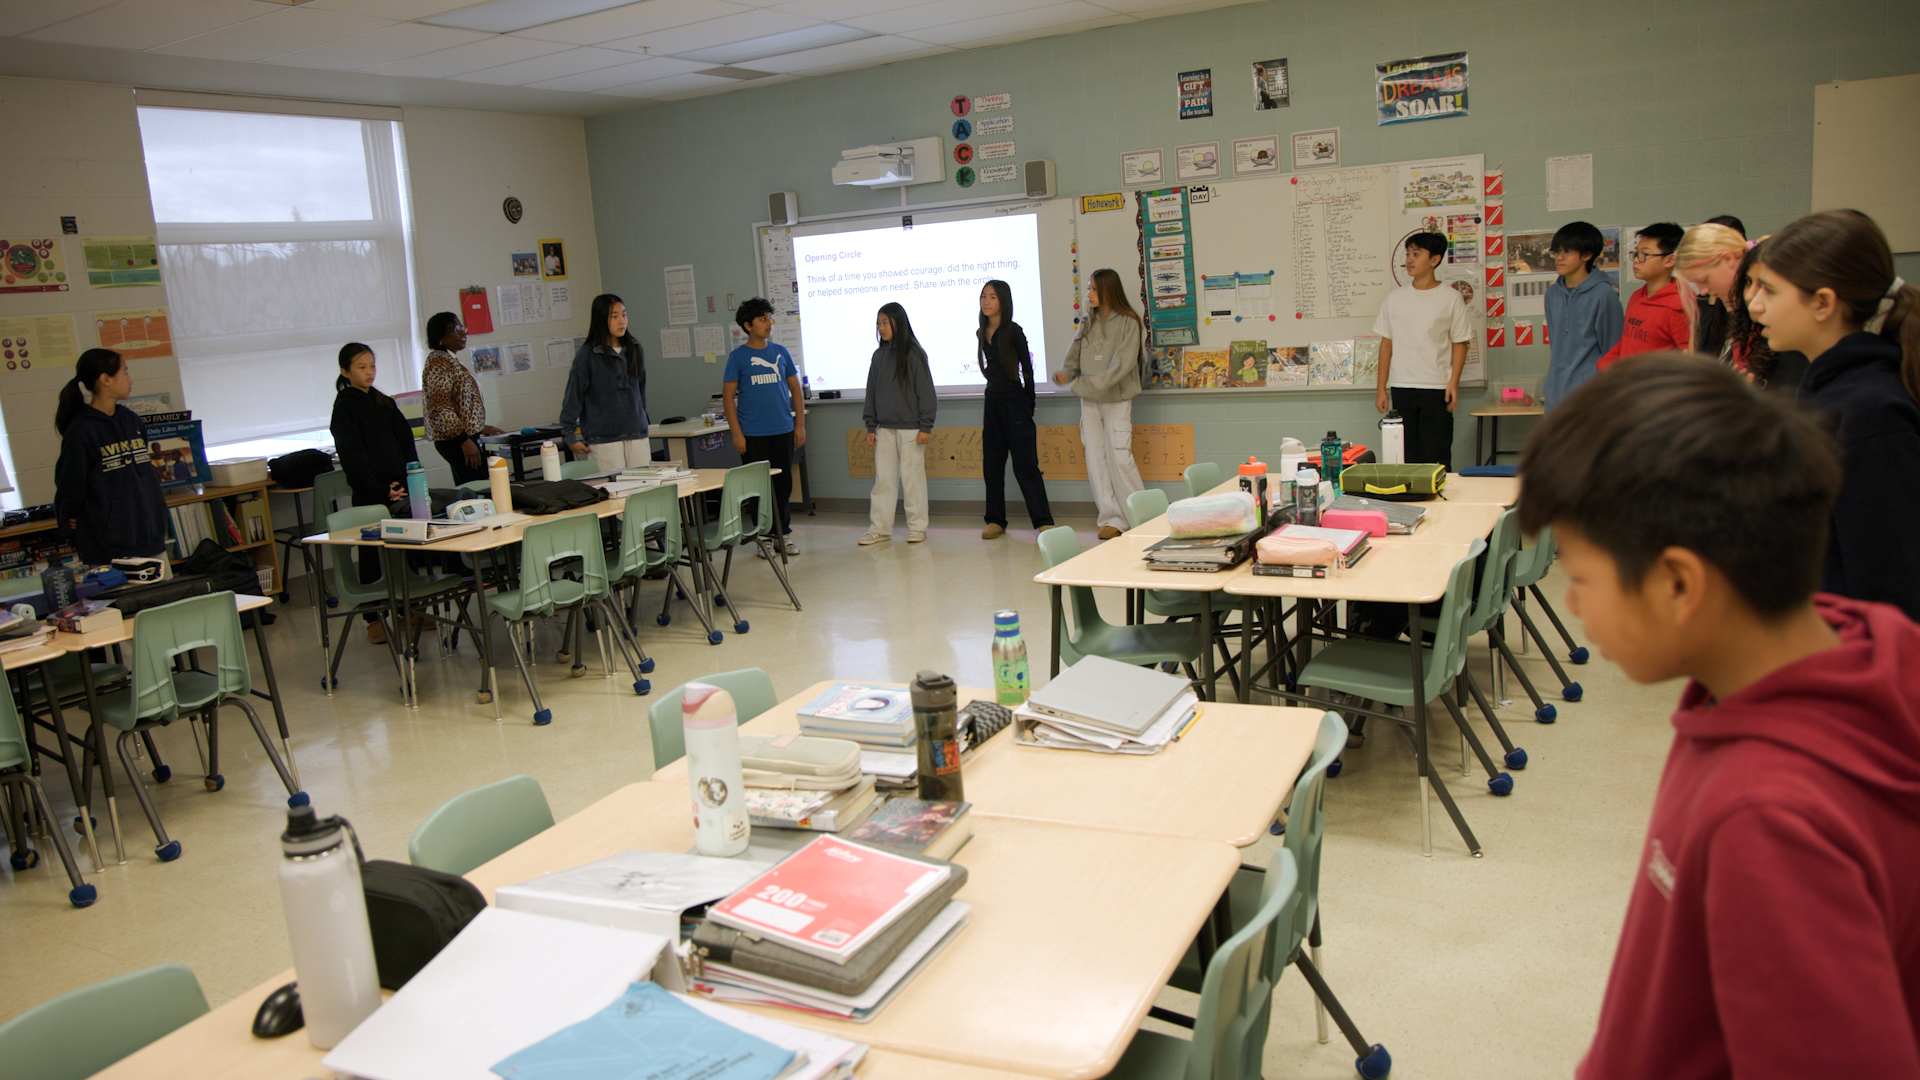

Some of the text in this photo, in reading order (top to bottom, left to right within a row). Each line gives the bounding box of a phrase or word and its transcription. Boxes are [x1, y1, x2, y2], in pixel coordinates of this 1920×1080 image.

[1386, 61, 1430, 74] Let your
[1180, 73, 1200, 82] Learning
[1382, 66, 1464, 105] DREAMS
[955, 98, 966, 114] T
[981, 96, 1004, 104] Thinking
[1184, 97, 1207, 108] PAIN
[1395, 93, 1463, 118] SOAR!
[1186, 108, 1194, 116] the
[980, 118, 1009, 127] Application
[955, 122, 970, 139] A
[980, 143, 1013, 151] Communication
[957, 146, 969, 162] C
[983, 166, 1013, 175] Knowledge
[960, 169, 972, 186] K
[1298, 171, 1374, 189] Paragraph Portfolio
[1211, 187, 1221, 199] 1
[1087, 196, 1120, 210] Homework
[805, 251, 862, 263] Opening Circle
[807, 275, 827, 284] Think
[829, 274, 835, 282] of
[845, 273, 860, 281] time
[863, 273, 876, 281] you
[879, 268, 908, 277] showed
[947, 264, 959, 272] did
[977, 261, 995, 271] right
[997, 259, 1021, 269] thing,
[817, 287, 842, 297] helped
[844, 284, 878, 294] someone
[913, 279, 937, 290] Share
[940, 278, 955, 287] with
[958, 277, 970, 286] the
[1624, 324, 1648, 342] ULTURE
[1233, 344, 1266, 354] Name Jar
[750, 373, 778, 385] PUMA
[152, 413, 181, 422] FAMILY
[1046, 427, 1065, 435] PLACE
[1150, 426, 1182, 435] BILLIONS
[423, 480, 432, 519] YDRATED
[755, 884, 808, 909] 200
